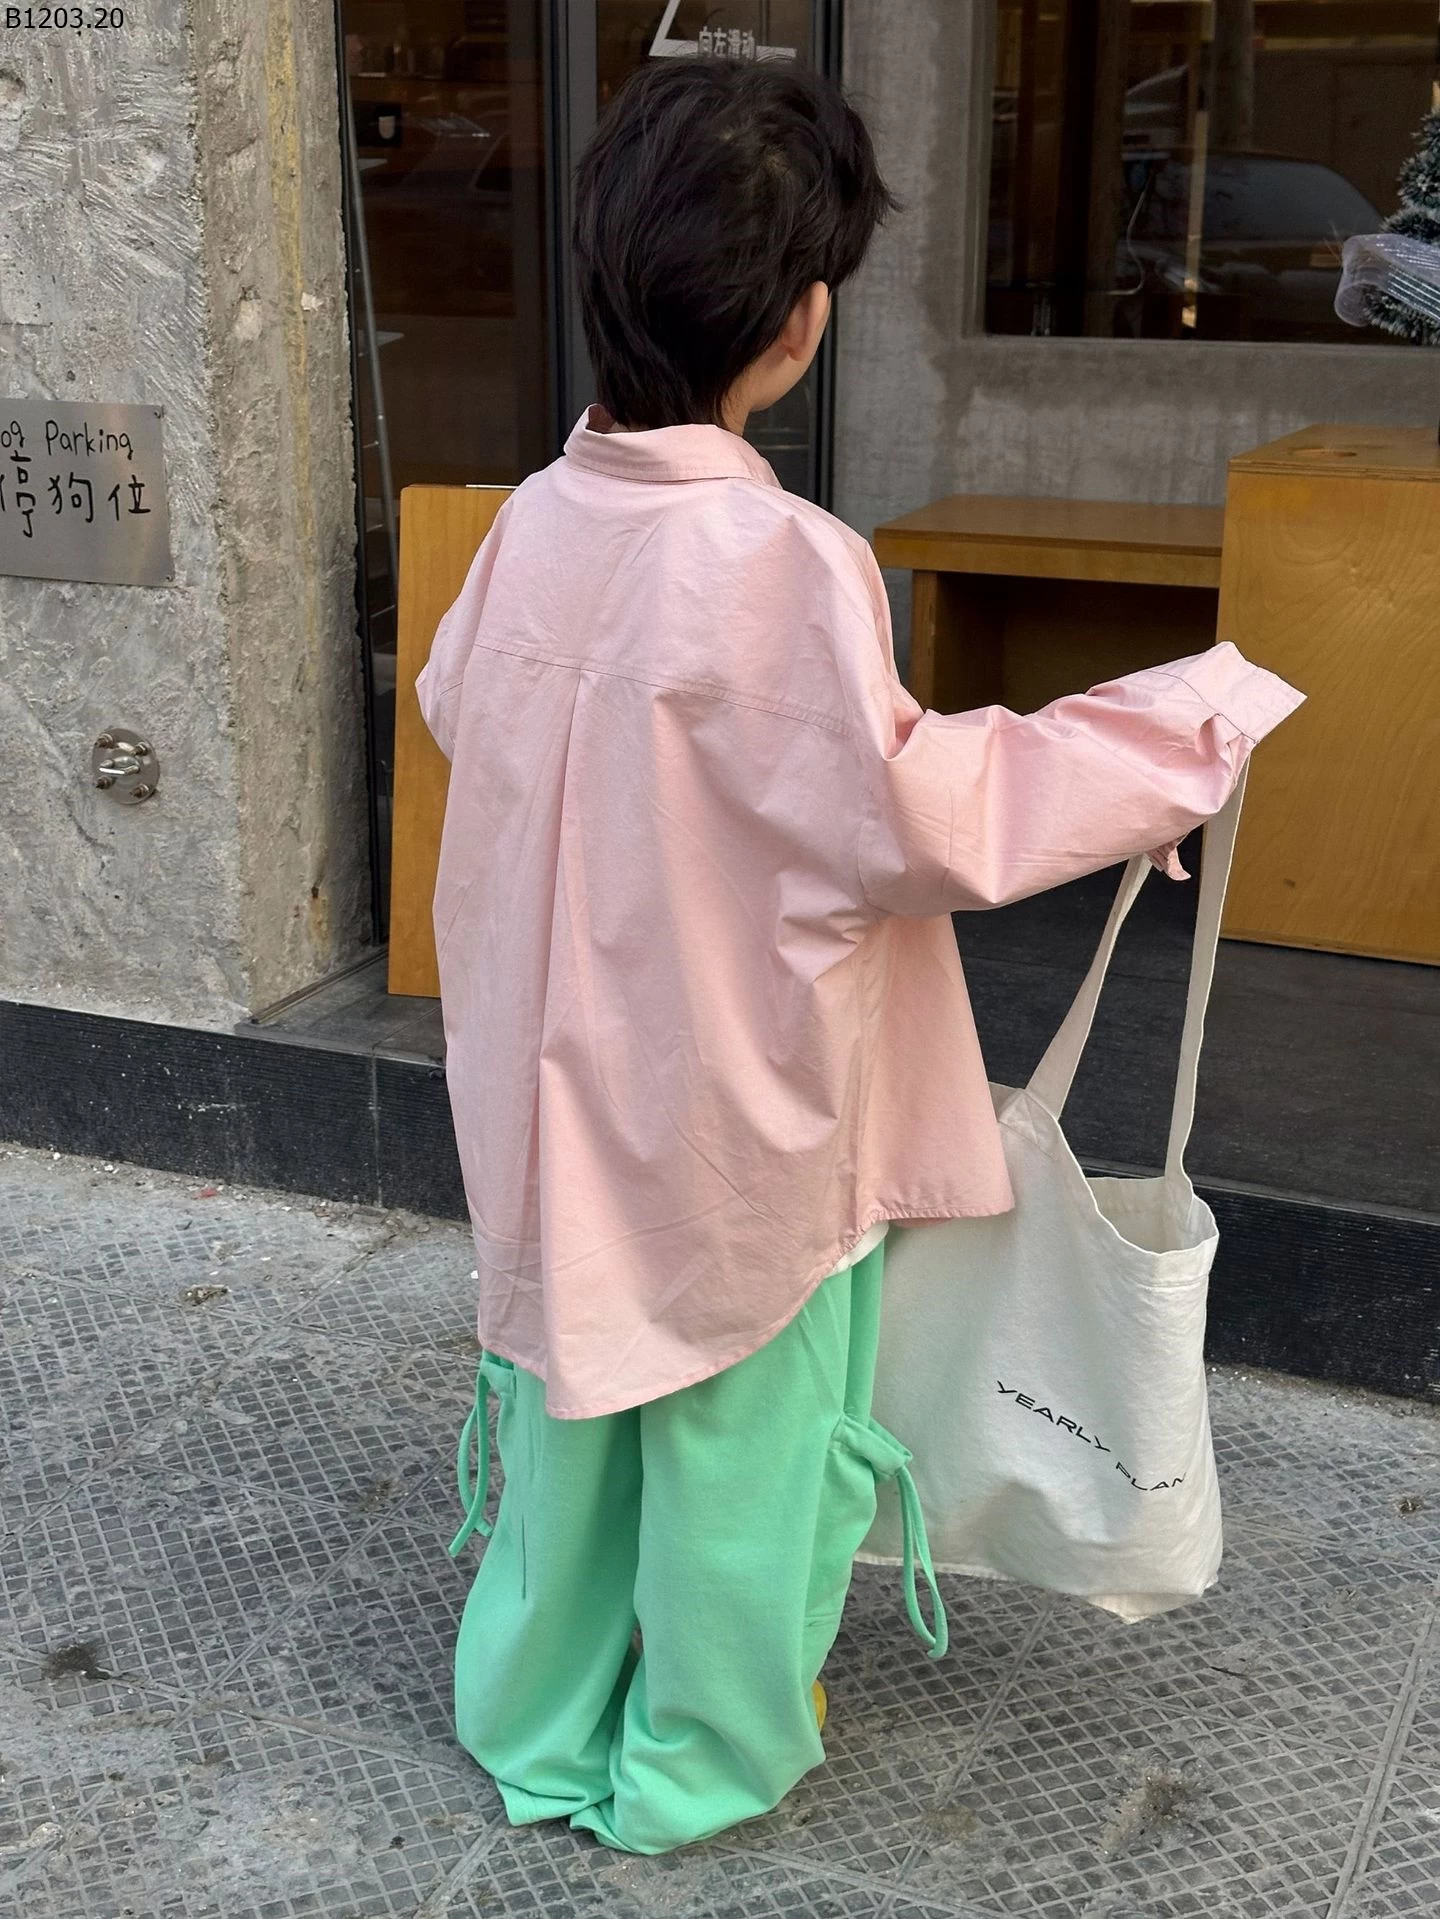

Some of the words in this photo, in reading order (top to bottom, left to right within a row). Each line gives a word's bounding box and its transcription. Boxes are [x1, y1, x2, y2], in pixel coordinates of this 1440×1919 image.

[0, 420, 25, 448] og
[45, 419, 134, 460] Parking
[0, 450, 151, 538] 停狗位
[996, 1380, 1111, 1453] YEARLY
[1115, 1461, 1187, 1492] PLAN
